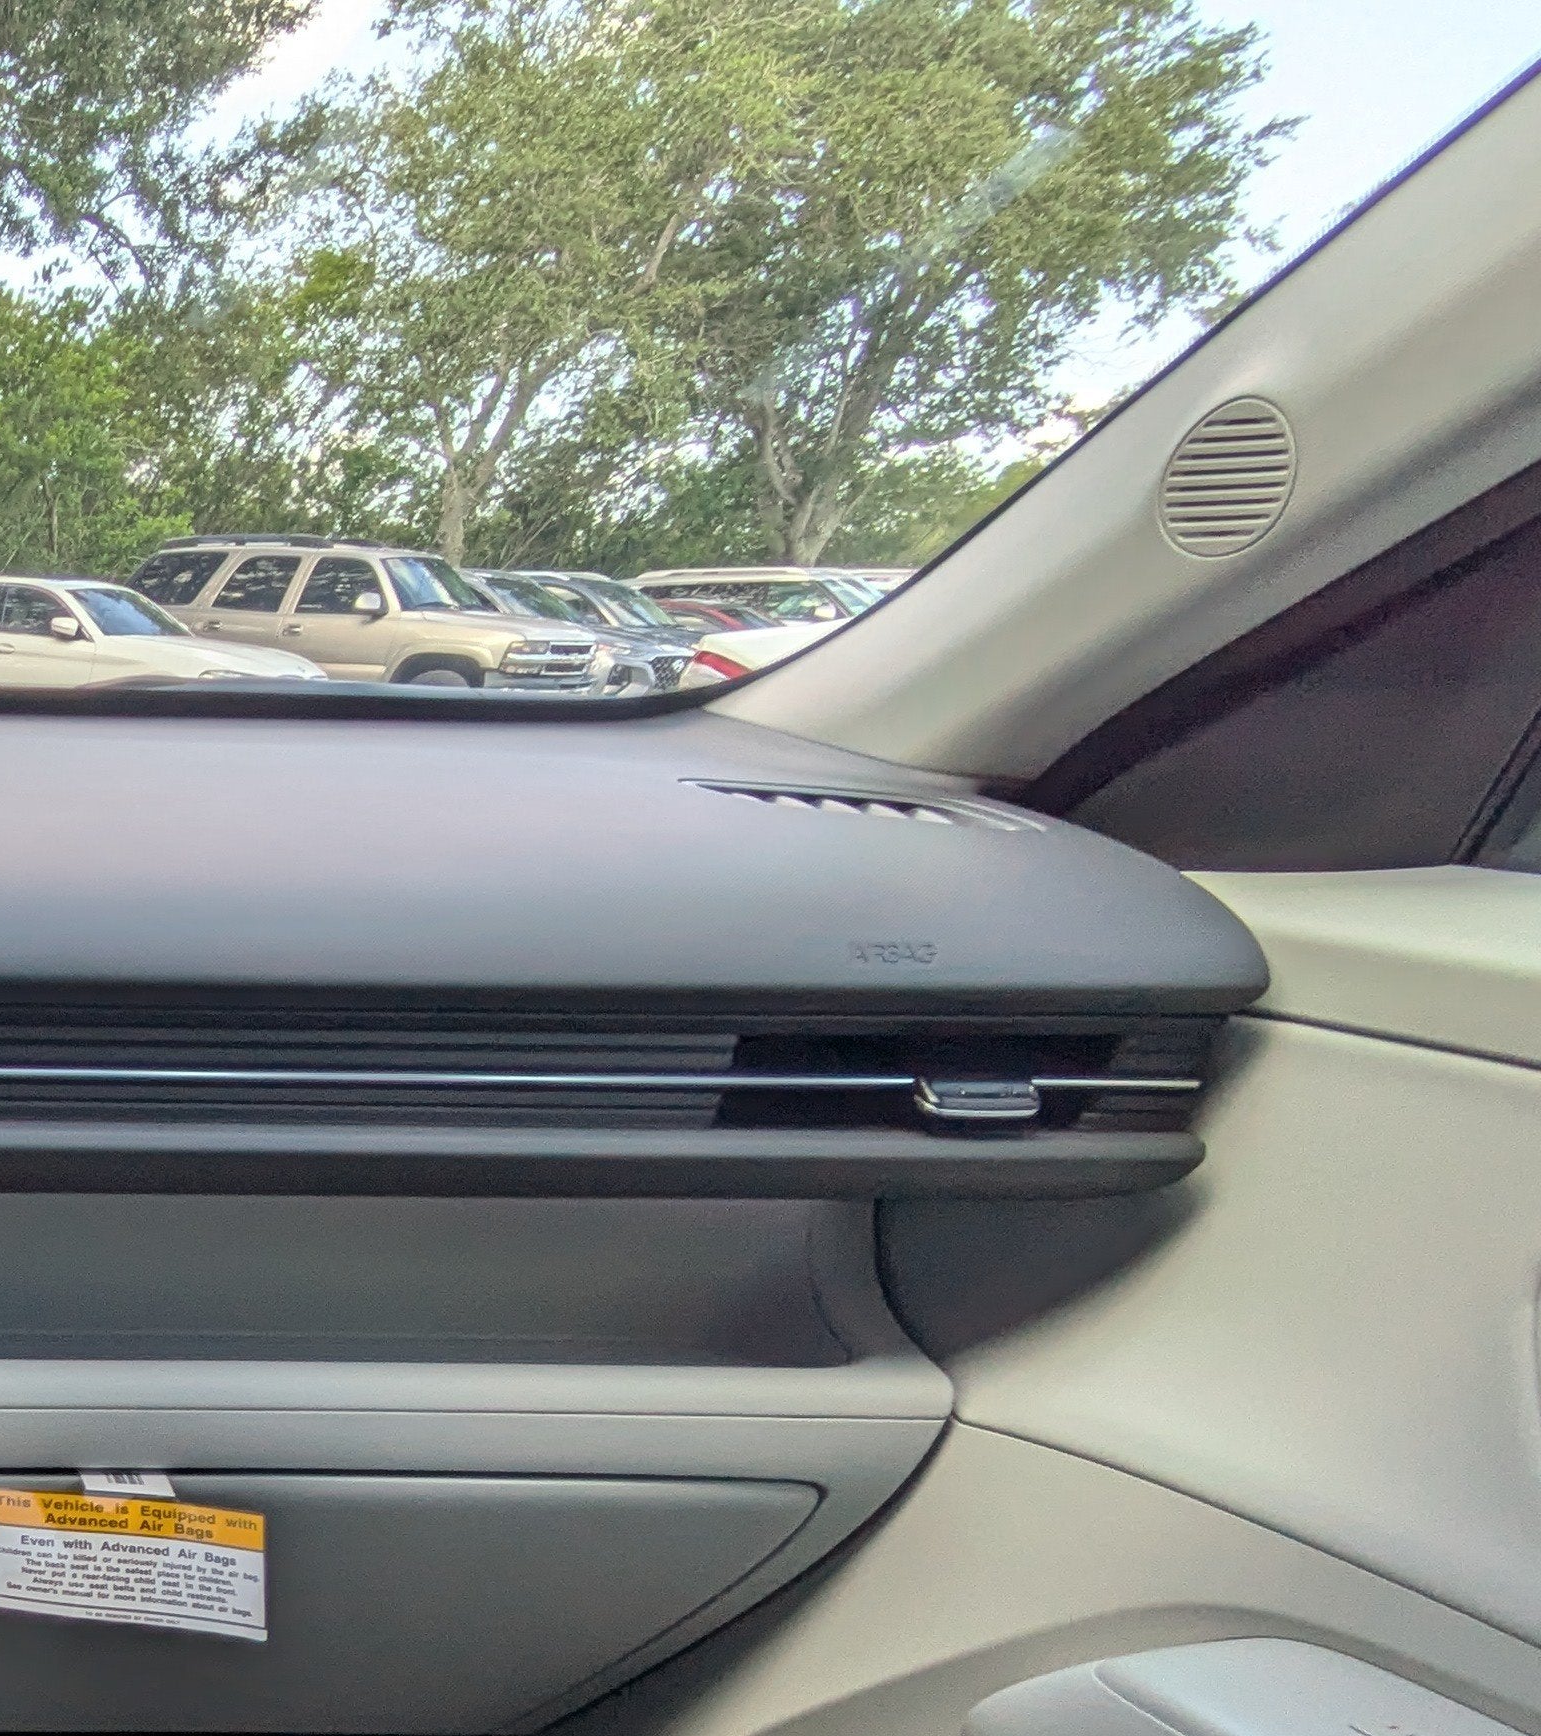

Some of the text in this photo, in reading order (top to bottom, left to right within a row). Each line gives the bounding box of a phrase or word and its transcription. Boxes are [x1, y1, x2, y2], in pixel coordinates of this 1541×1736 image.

[41, 1498, 104, 1514] Vehicle
[115, 1502, 129, 1515] is
[140, 1504, 216, 1525] Equipped
[225, 1517, 258, 1531] with
[44, 1512, 214, 1540] Advanced Air Bags
[20, 1534, 237, 1567] Even with Advanced Air Bags
[25, 1558, 42, 1567] The
[70, 1563, 89, 1571] seat
[106, 1565, 121, 1574] the
[36, 1551, 53, 1559] can
[57, 1551, 69, 1560] be
[196, 1565, 207, 1575] by
[211, 1567, 225, 1576] the
[227, 1570, 239, 1578] air
[6, 1581, 22, 1591] See
[68, 1581, 85, 1589] use
[89, 1582, 108, 1590] seat
[198, 1583, 212, 1592] the
